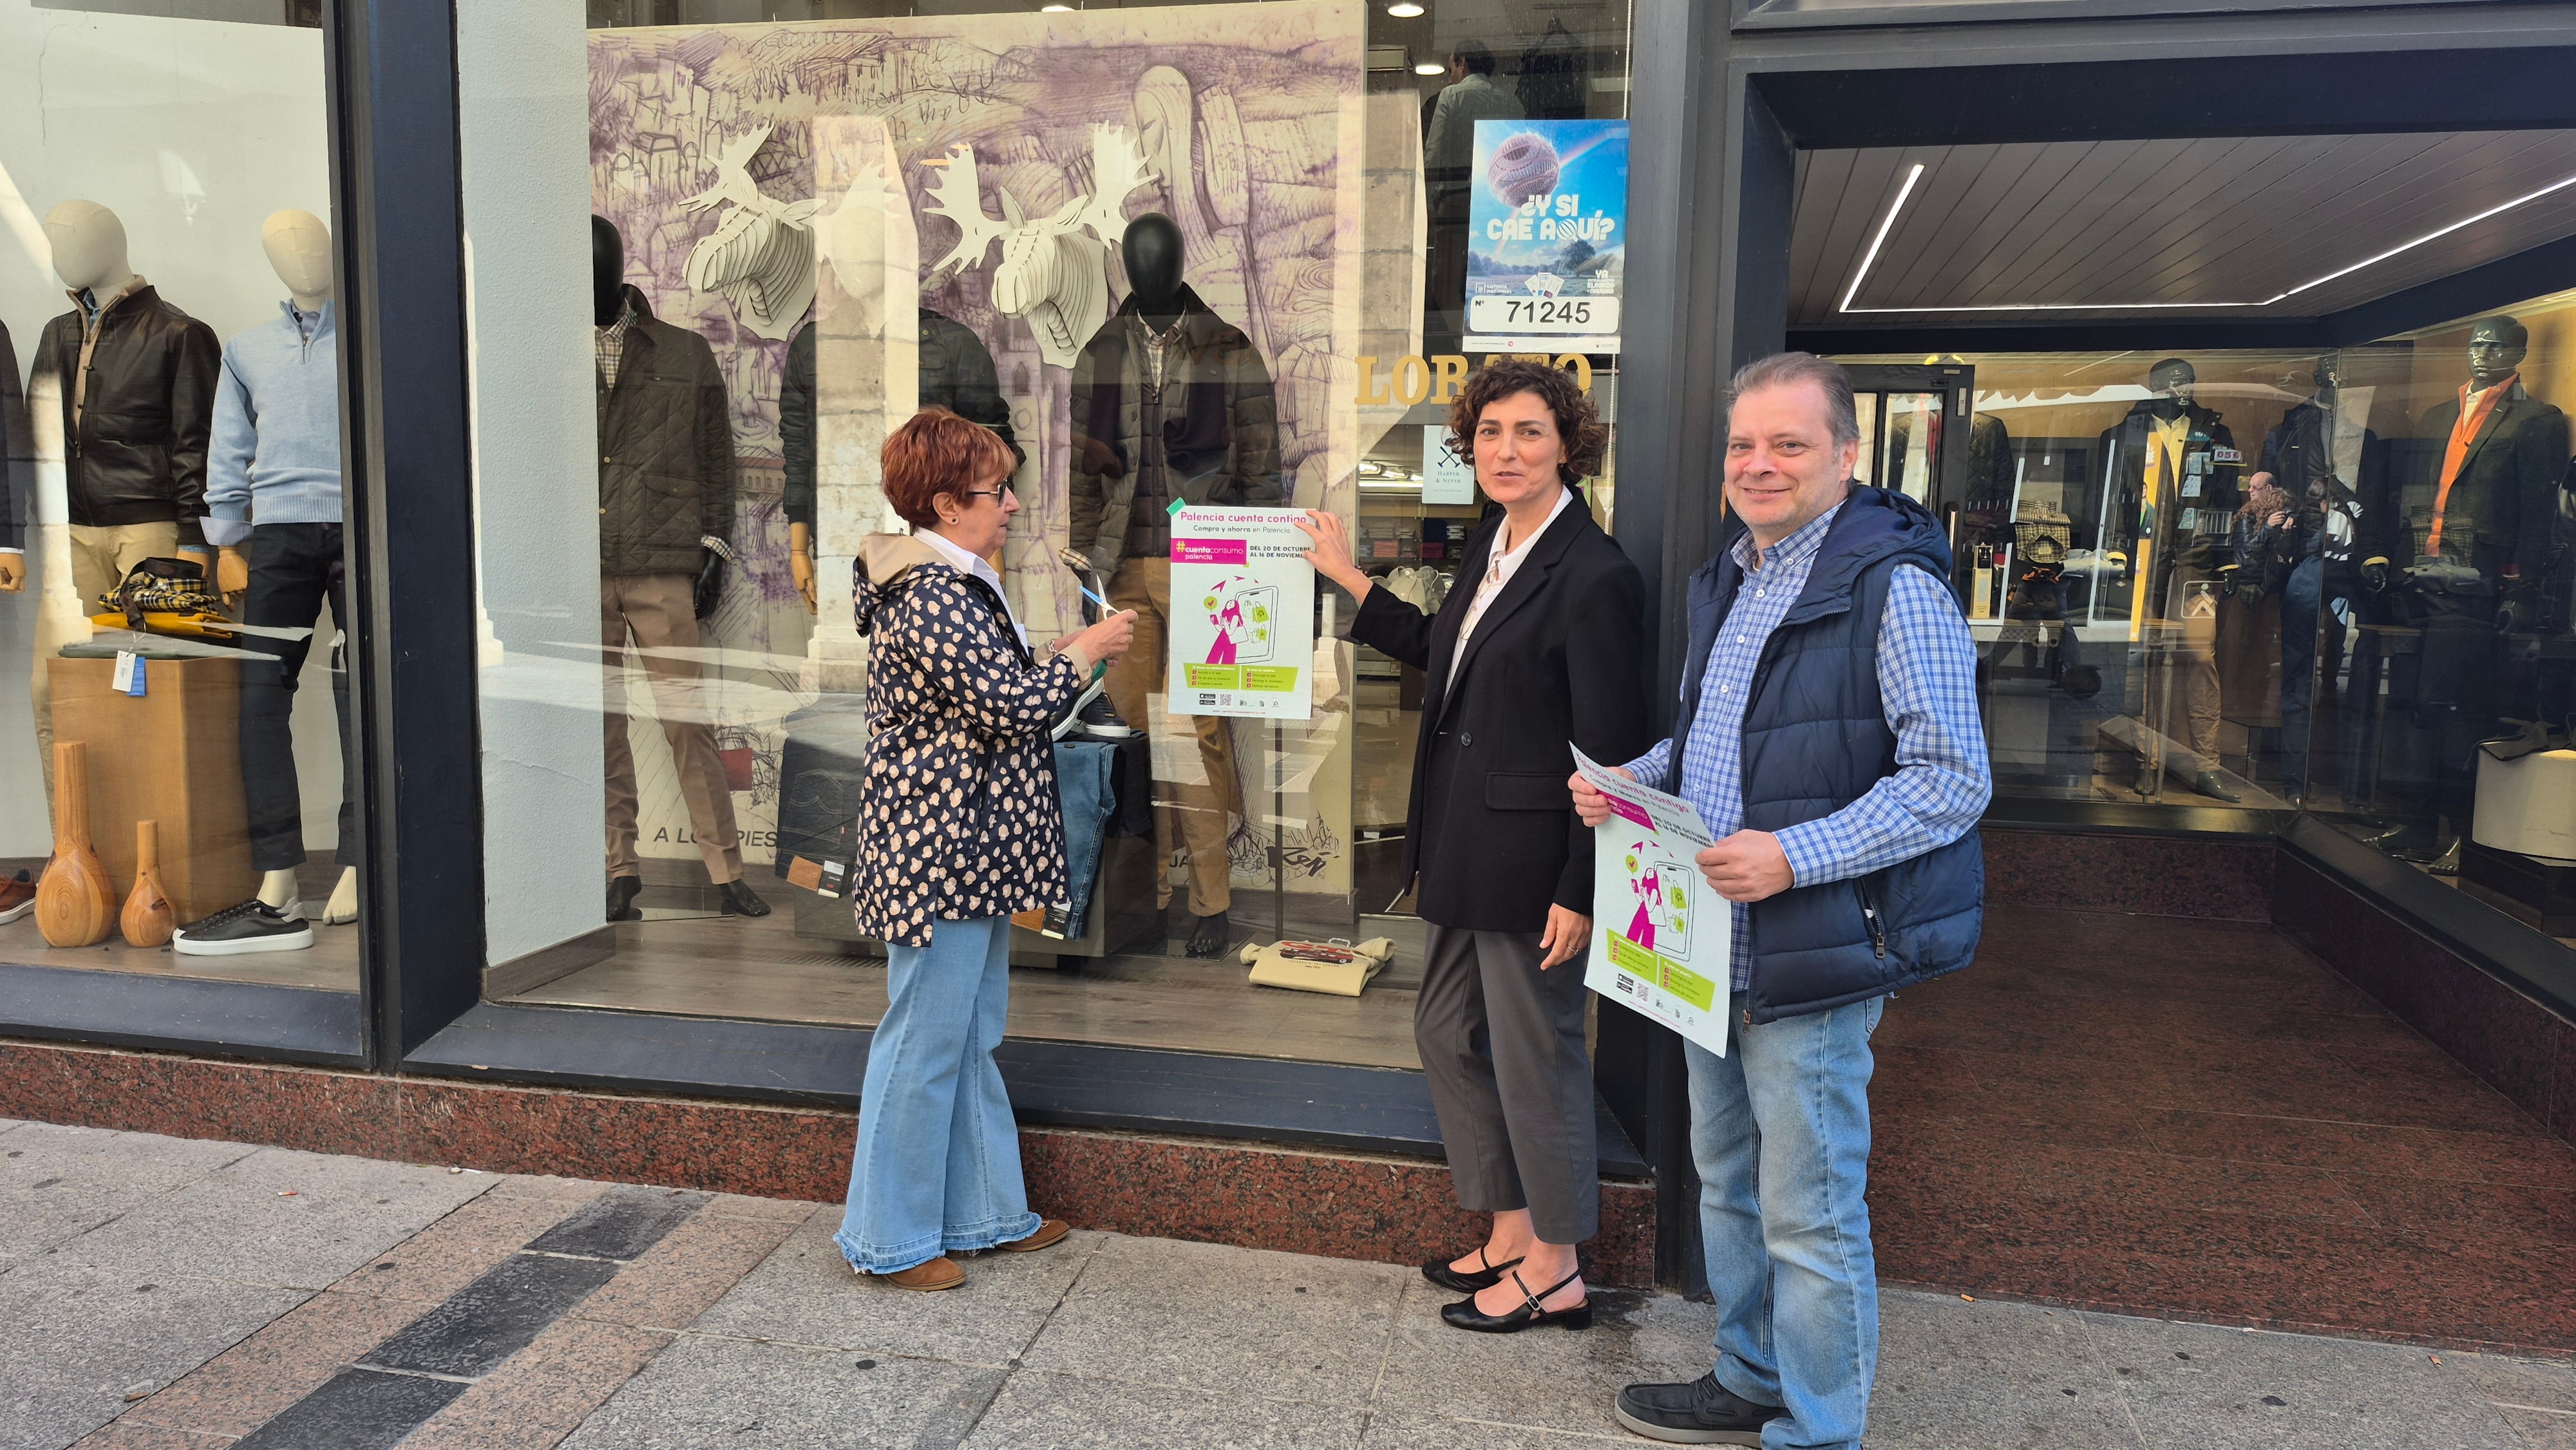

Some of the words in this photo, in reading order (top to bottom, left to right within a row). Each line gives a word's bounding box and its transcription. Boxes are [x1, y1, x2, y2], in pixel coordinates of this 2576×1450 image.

[1520, 194, 1551, 217] ¿Y
[1555, 194, 1579, 217] SI
[1487, 218, 1534, 240] CAE
[1540, 210, 1615, 242] AQUÍ?
[1595, 269, 1608, 279] YA
[1506, 301, 1591, 324] 71245
[1354, 353, 1592, 406] LOBO
[1180, 512, 1224, 521] Palencia
[1228, 514, 1264, 522] cuenta
[1577, 753, 1610, 782] Palencia
[1612, 778, 1647, 797] cuenta
[1649, 794, 1689, 813] contigo
[653, 827, 669, 842] A
